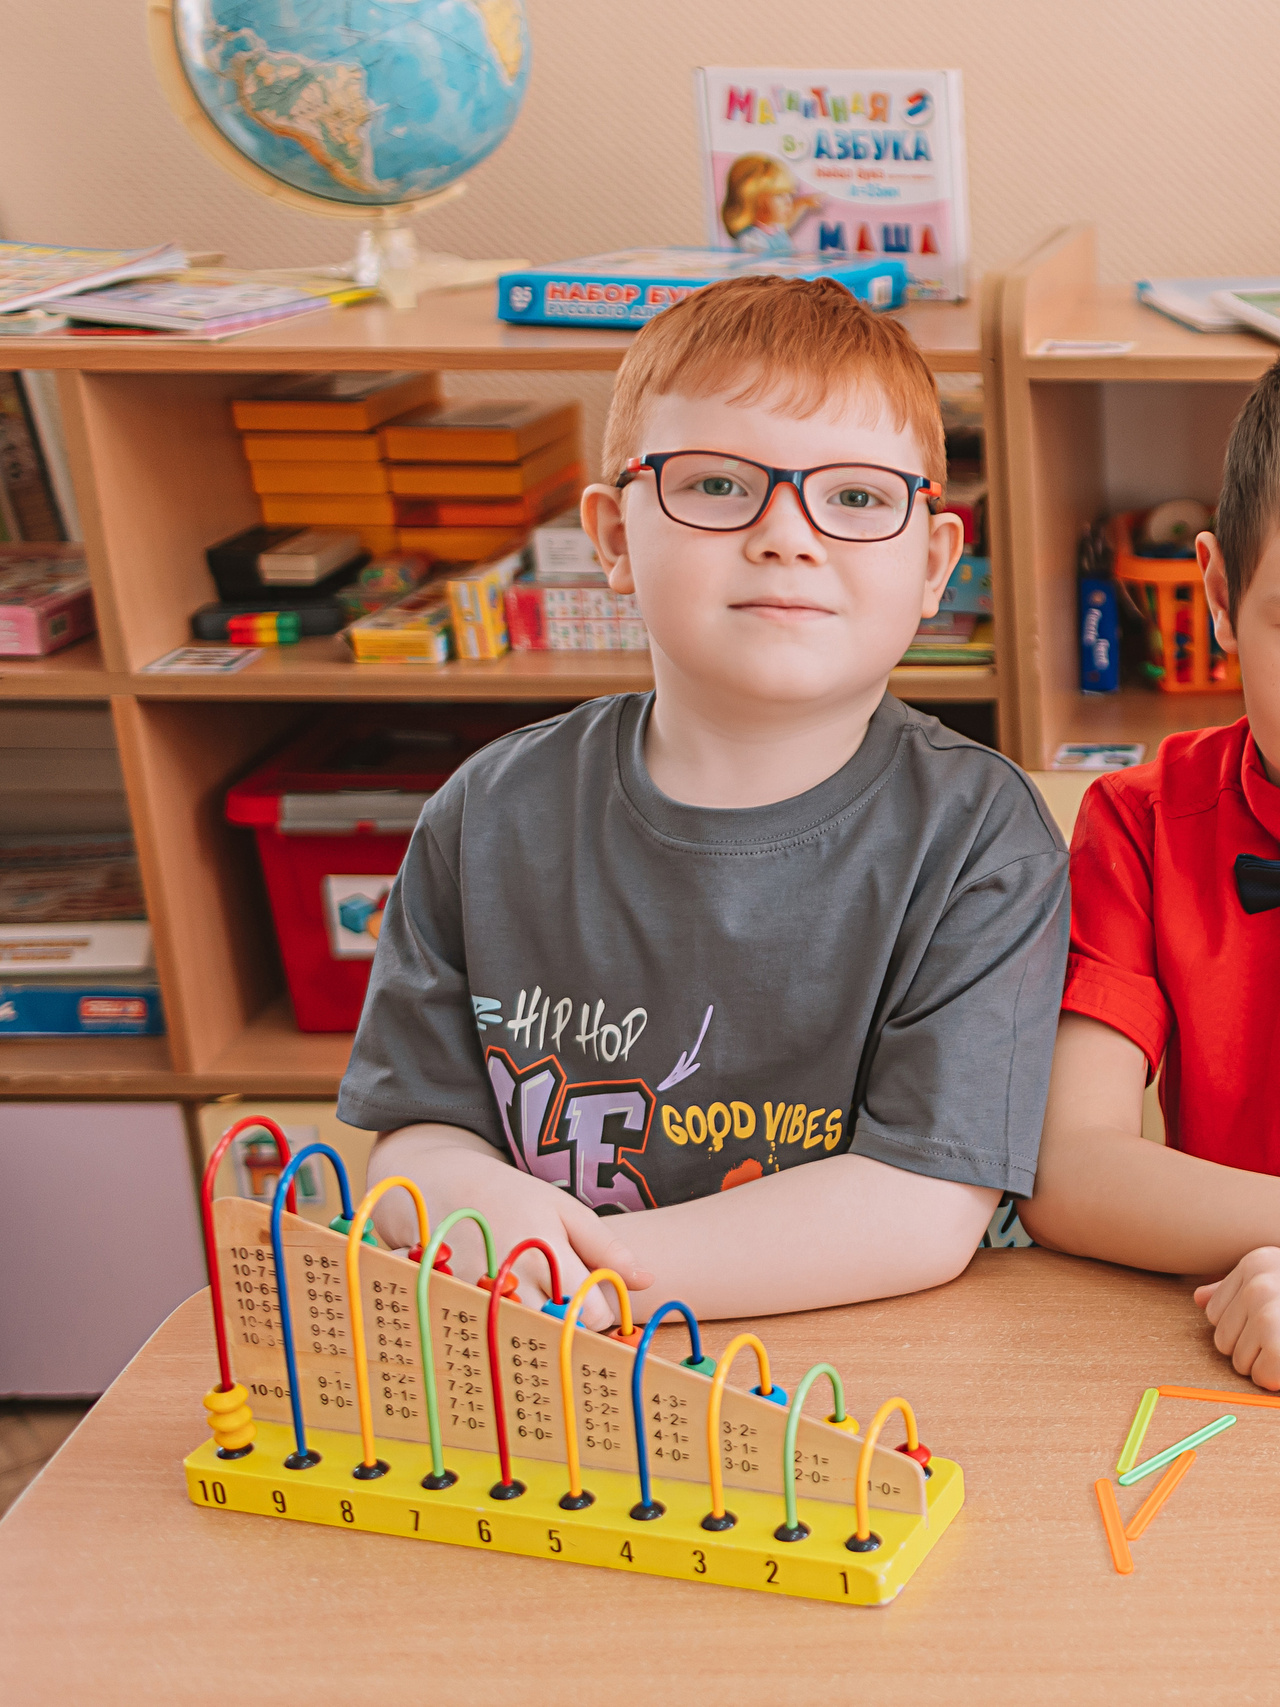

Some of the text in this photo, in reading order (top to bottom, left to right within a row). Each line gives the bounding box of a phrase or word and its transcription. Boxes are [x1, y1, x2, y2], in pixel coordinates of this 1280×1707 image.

[814, 128, 933, 161] АЗБУКА
[819, 221, 938, 254] МАША
[547, 283, 640, 304] НАБОР
[507, 985, 573, 1052] HIP
[576, 998, 648, 1062] HOP
[662, 1101, 843, 1151] GOOD VIBES
[231, 1247, 274, 1261] 10-8=
[303, 1254, 339, 1268] 9-8=
[233, 1264, 276, 1277] 10-7=
[305, 1271, 341, 1285] 9-7=
[235, 1281, 278, 1295] 10-6=
[373, 1280, 407, 1294] 8-7=
[307, 1288, 342, 1303] 9-6=
[237, 1298, 280, 1312] 10-5=
[375, 1298, 409, 1313] 8-6=
[309, 1306, 344, 1320] 9-5=
[442, 1308, 477, 1323] 7-6=
[376, 1316, 410, 1330] 8-5=
[311, 1324, 345, 1338] 9-4=
[443, 1326, 478, 1341] 7-5=
[313, 1341, 347, 1355] 9-3=
[378, 1333, 412, 1348] 8-4=
[511, 1336, 547, 1351] 6-5=
[445, 1343, 480, 1358] 7-4=
[446, 1361, 481, 1377] 7-3=
[513, 1354, 548, 1369] 6-4=
[581, 1364, 617, 1379] 5-4=
[318, 1376, 351, 1390] 9-1=
[448, 1379, 482, 1394] 7-2=
[514, 1372, 549, 1387] 6-3=
[384, 1386, 417, 1401] 8-1=
[515, 1389, 550, 1405] 6-2=
[583, 1382, 618, 1397] 5-3=
[320, 1393, 353, 1408] 9-0=
[450, 1397, 484, 1412] 7-1=
[584, 1400, 619, 1415] 5-2=
[652, 1393, 687, 1408] 4-3=
[385, 1403, 418, 1418] 8-0=
[517, 1407, 552, 1422] 6-1=
[653, 1411, 688, 1425] 4-2=
[451, 1414, 485, 1429] 7-0=
[585, 1418, 620, 1432] 5-1=
[723, 1421, 757, 1436] 3-2=
[518, 1425, 553, 1440] 6-0=
[654, 1429, 689, 1443] 4-1=
[586, 1435, 621, 1450] 5-0=
[724, 1439, 758, 1454] 3-1=
[655, 1447, 690, 1461] 4-0=
[795, 1450, 829, 1465] 2-1=
[725, 1457, 759, 1472] 3-0=
[795, 1468, 830, 1483] 2-0=
[198, 1479, 850, 1595] 10 9 8 7 6 5 4 3 2 1
